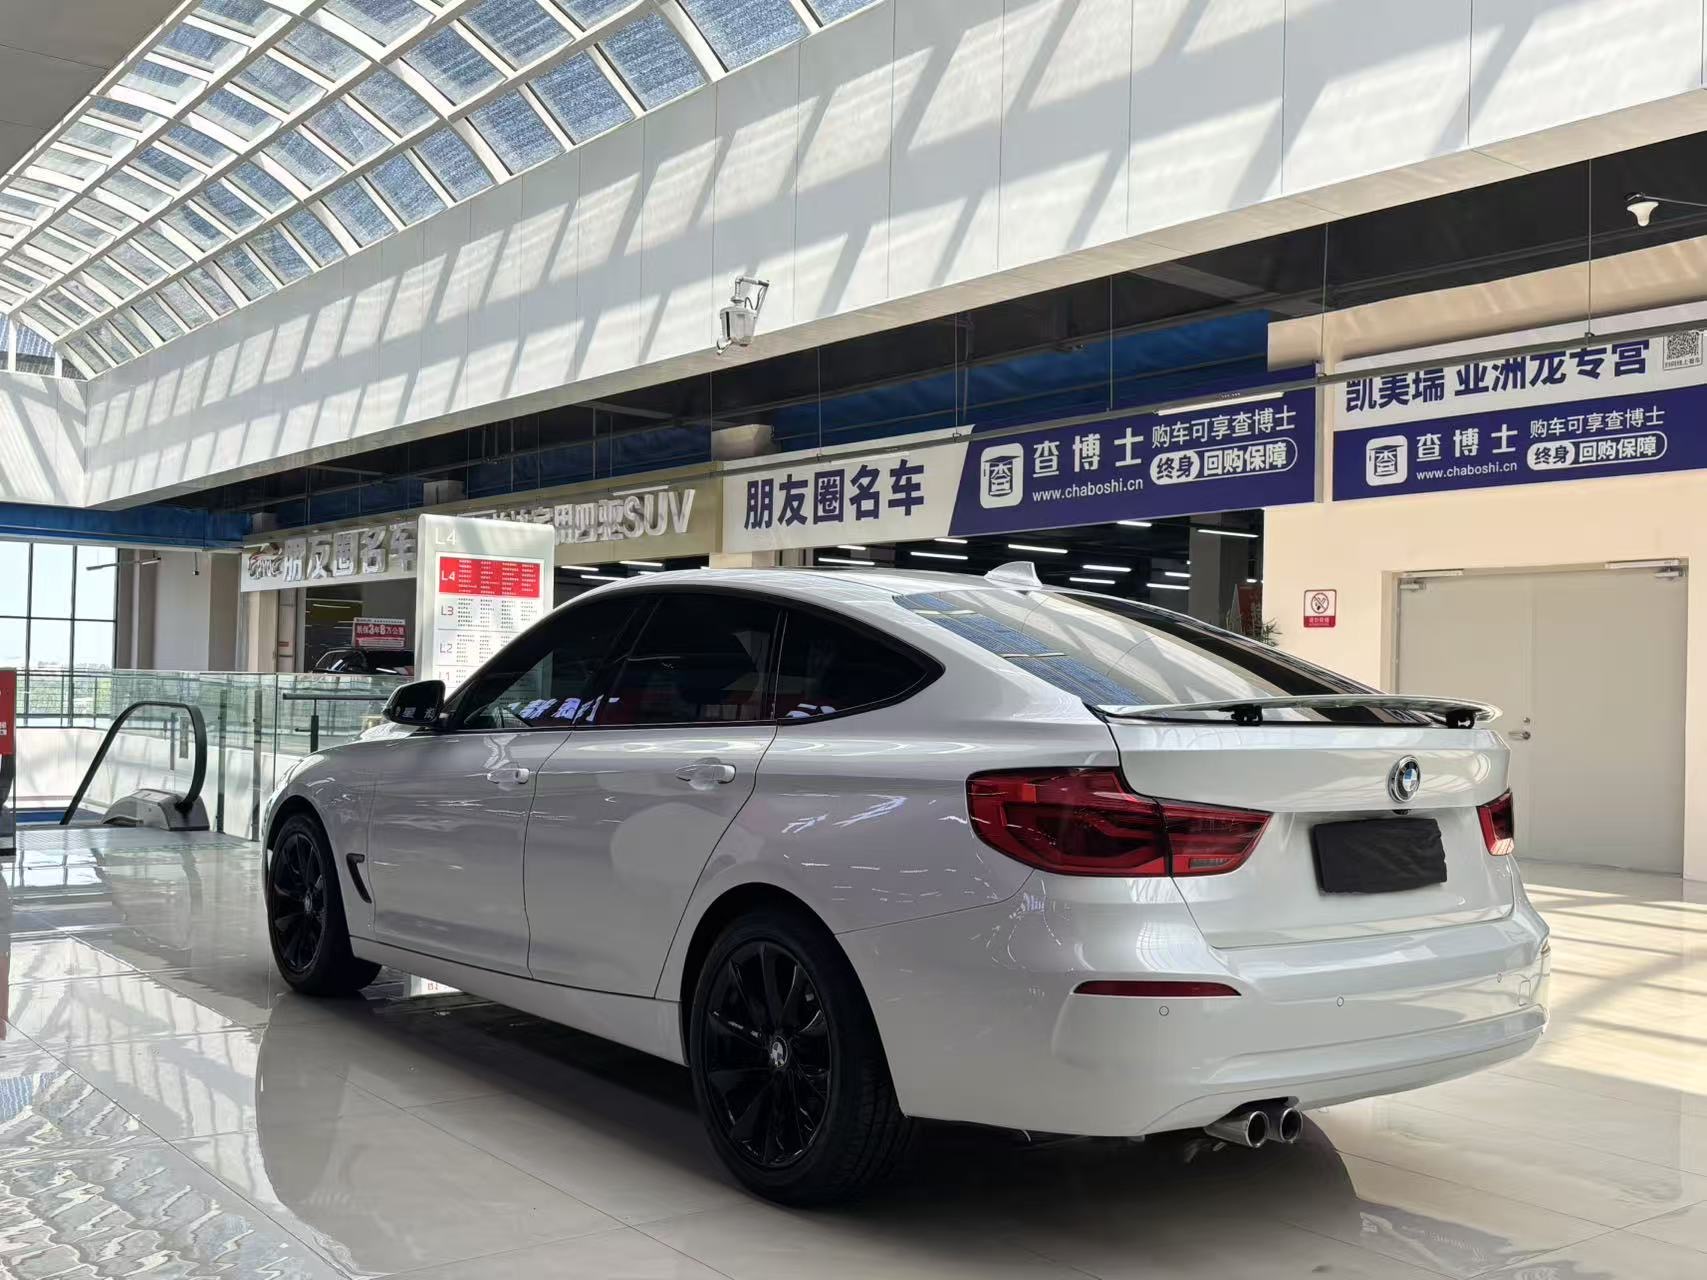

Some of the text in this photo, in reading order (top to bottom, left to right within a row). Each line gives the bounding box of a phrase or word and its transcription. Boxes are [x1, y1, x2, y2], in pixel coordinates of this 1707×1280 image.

[1344, 368, 1445, 413] 凯美瑞
[1151, 405, 1297, 449] 购车可享查博士
[1529, 405, 1666, 439] 购车可享查博士
[1032, 427, 1144, 478] 查博士
[1416, 424, 1518, 463] 查博士
[1416, 462, 1518, 480] www.chaboshi.cn
[744, 458, 925, 531] 朋友圈名车
[1032, 478, 1144, 502] www.chaboshi.cn
[284, 523, 416, 583] 朋友圈名车
[435, 527, 457, 546] L4
[441, 570, 456, 581] L4
[441, 605, 454, 616] L3
[440, 643, 453, 654] L2
